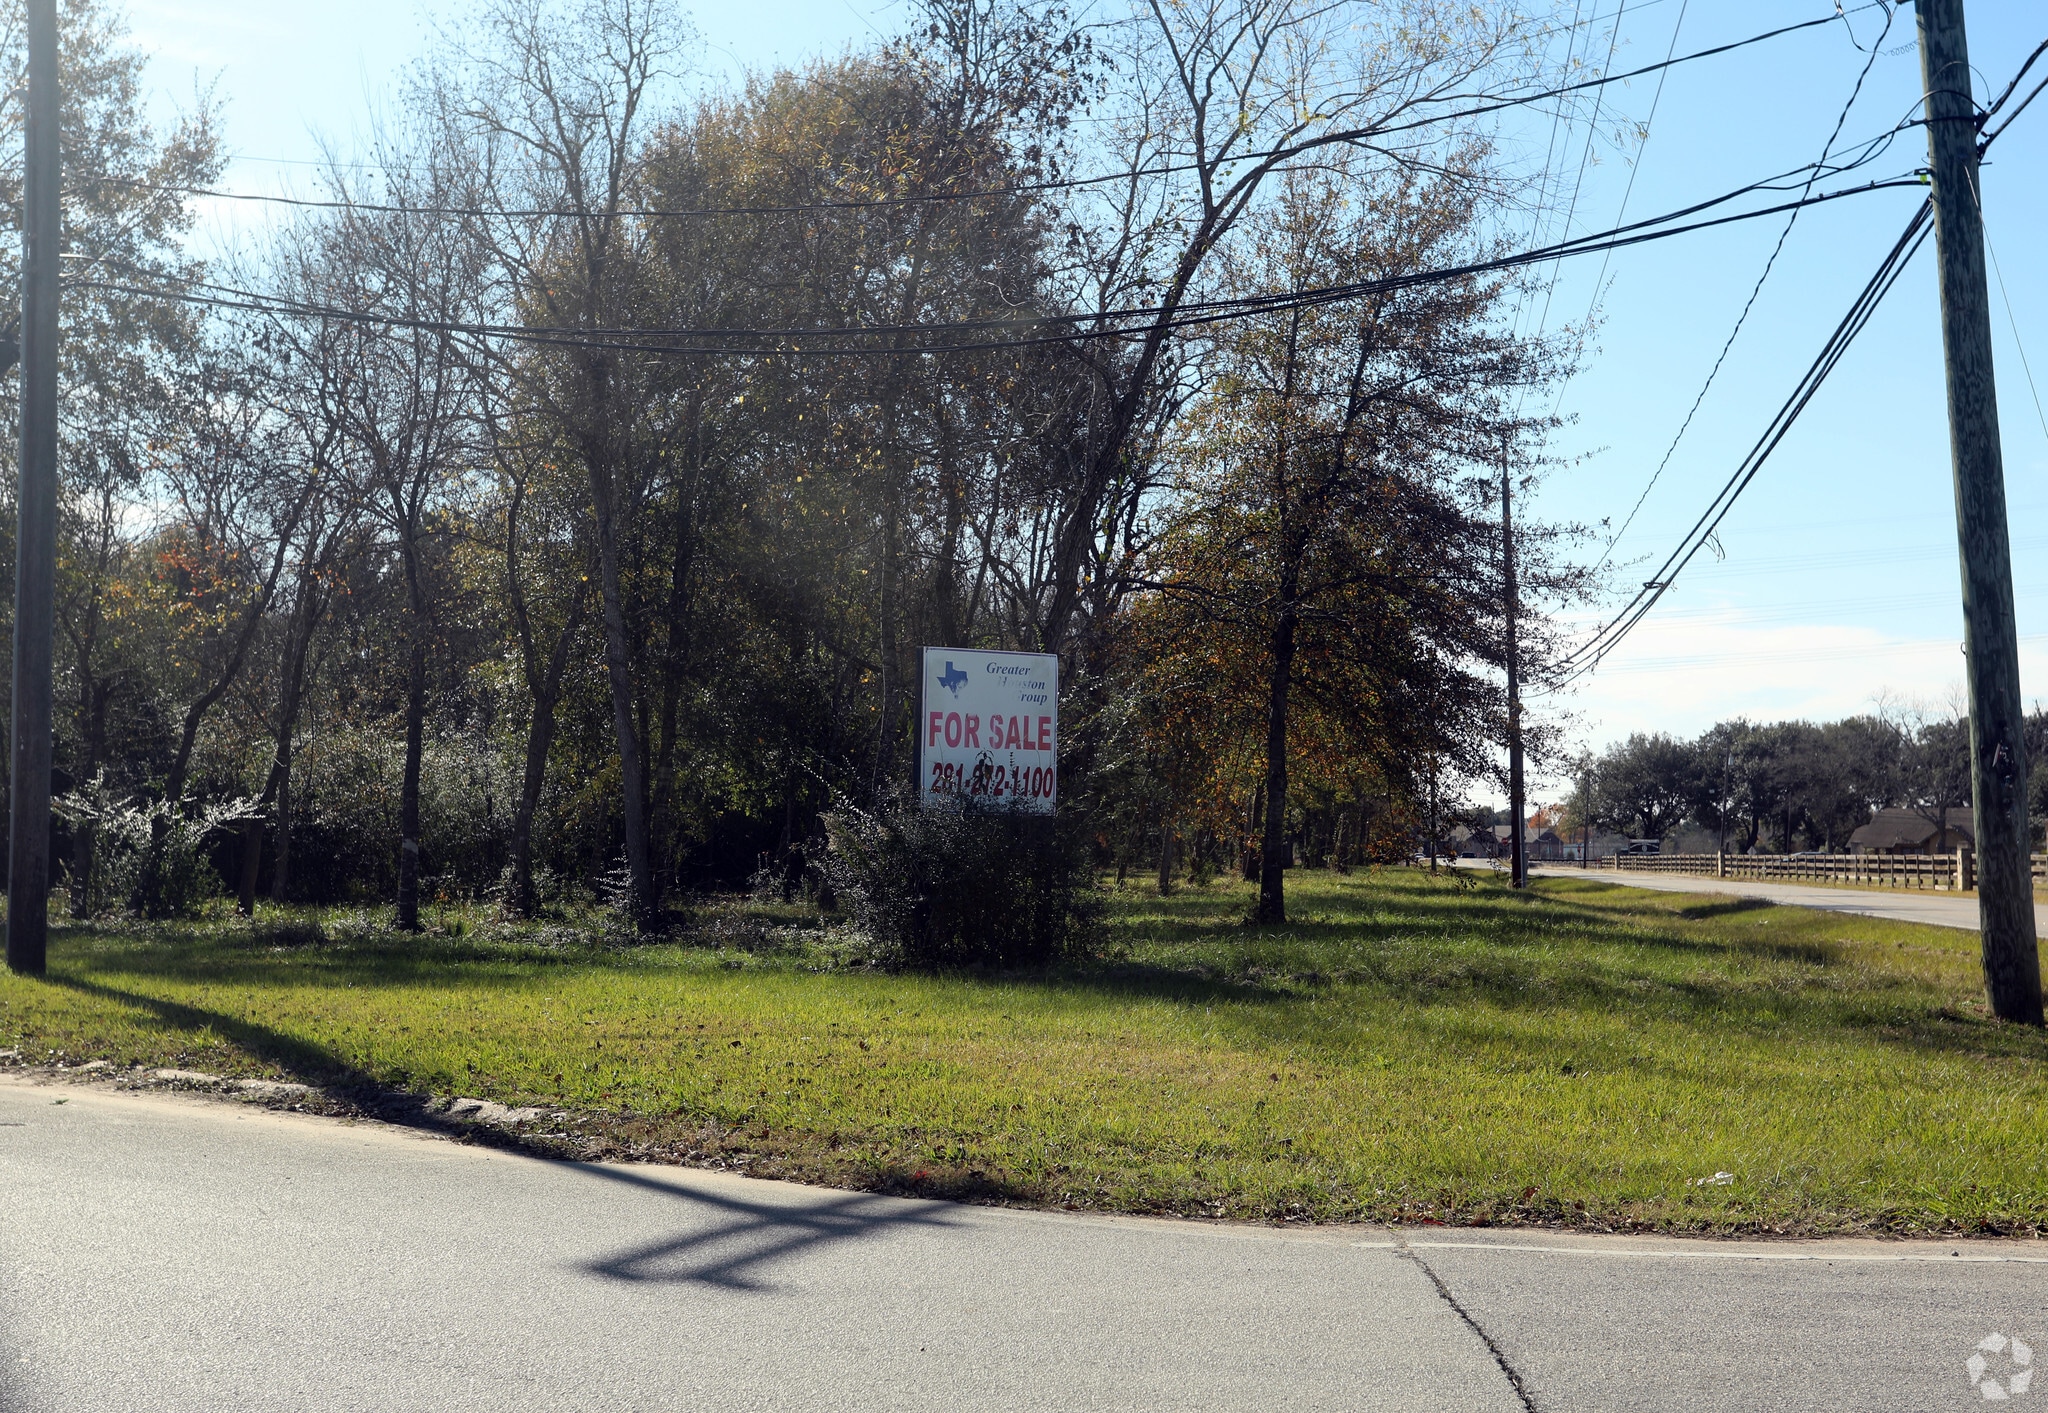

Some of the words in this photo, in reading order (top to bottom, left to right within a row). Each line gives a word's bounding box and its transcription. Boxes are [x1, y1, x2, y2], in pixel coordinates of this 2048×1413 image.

[986, 661, 1031, 675] Greater
[1017, 690, 1048, 706] roup
[928, 711, 980, 749] FOR
[988, 714, 1052, 751] SALE
